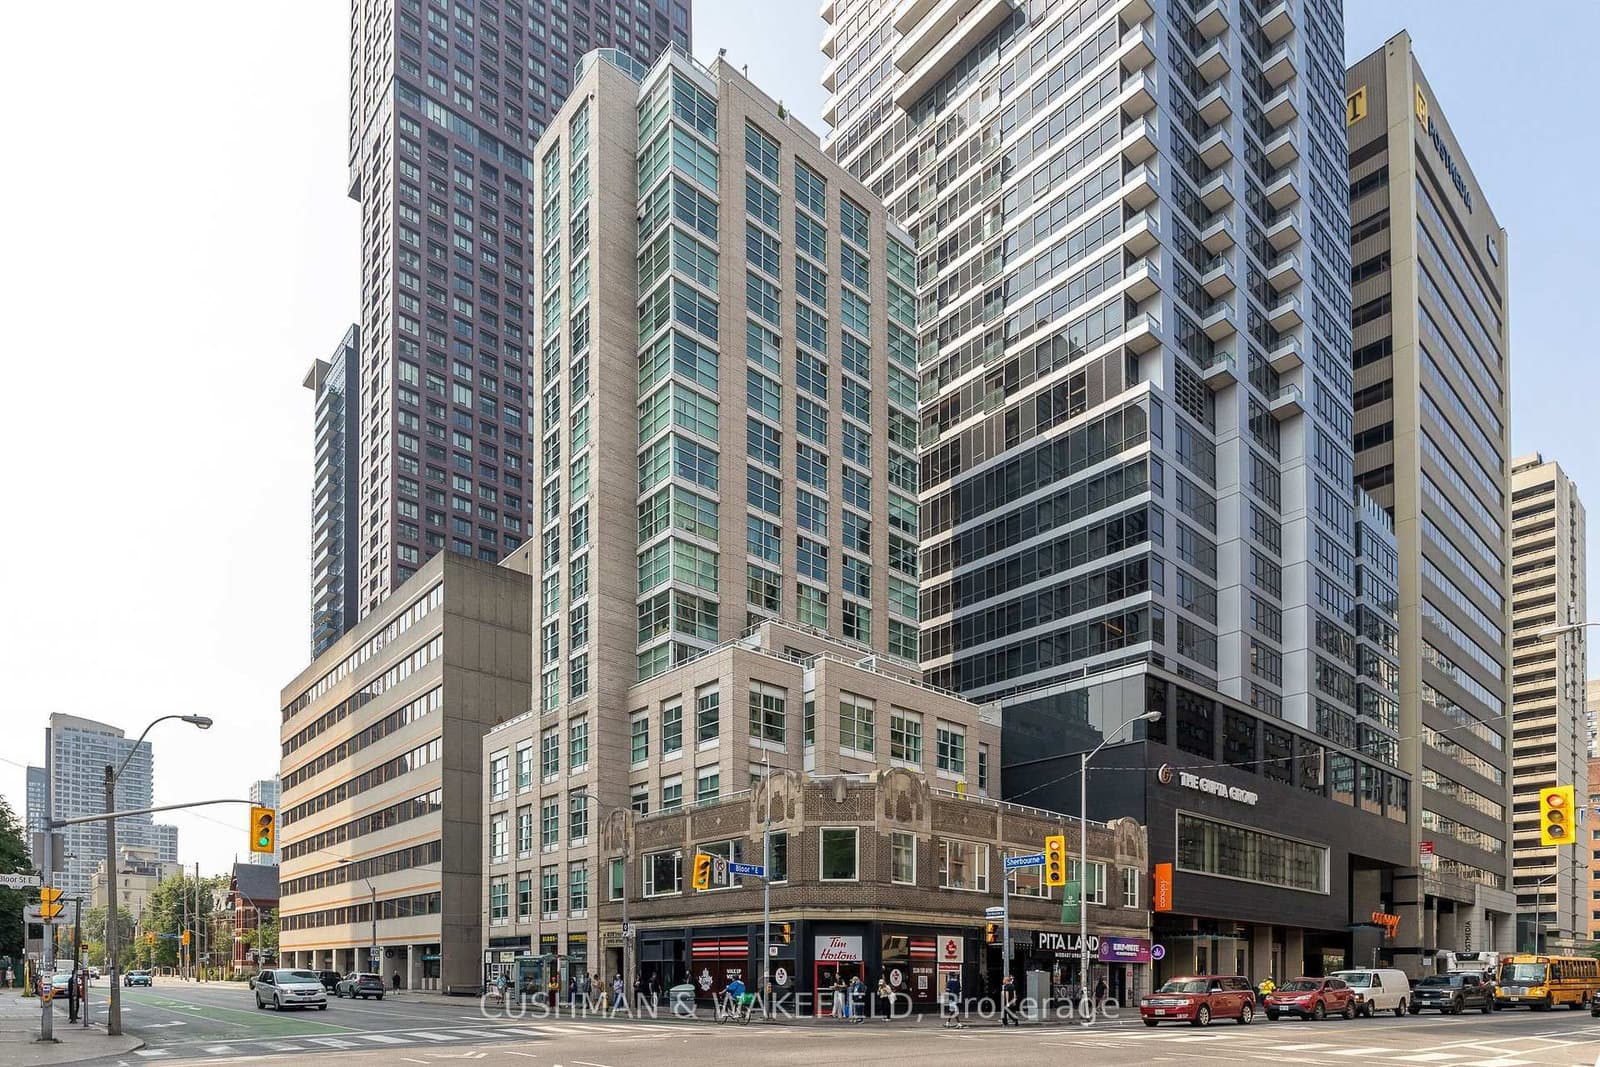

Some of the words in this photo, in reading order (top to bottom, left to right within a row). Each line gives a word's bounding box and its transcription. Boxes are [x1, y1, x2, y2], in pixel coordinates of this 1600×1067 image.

[1180, 771, 1199, 789] THE
[1199, 778, 1229, 798] GUPTA
[1229, 786, 1258, 806] GROUP
[1006, 857, 1040, 866] Sherbourne
[735, 864, 750, 873] Bloor
[829, 936, 847, 948] Tim
[1039, 932, 1066, 950] PITA
[1067, 934, 1099, 951] LAND
[820, 948, 857, 961] Hortons
